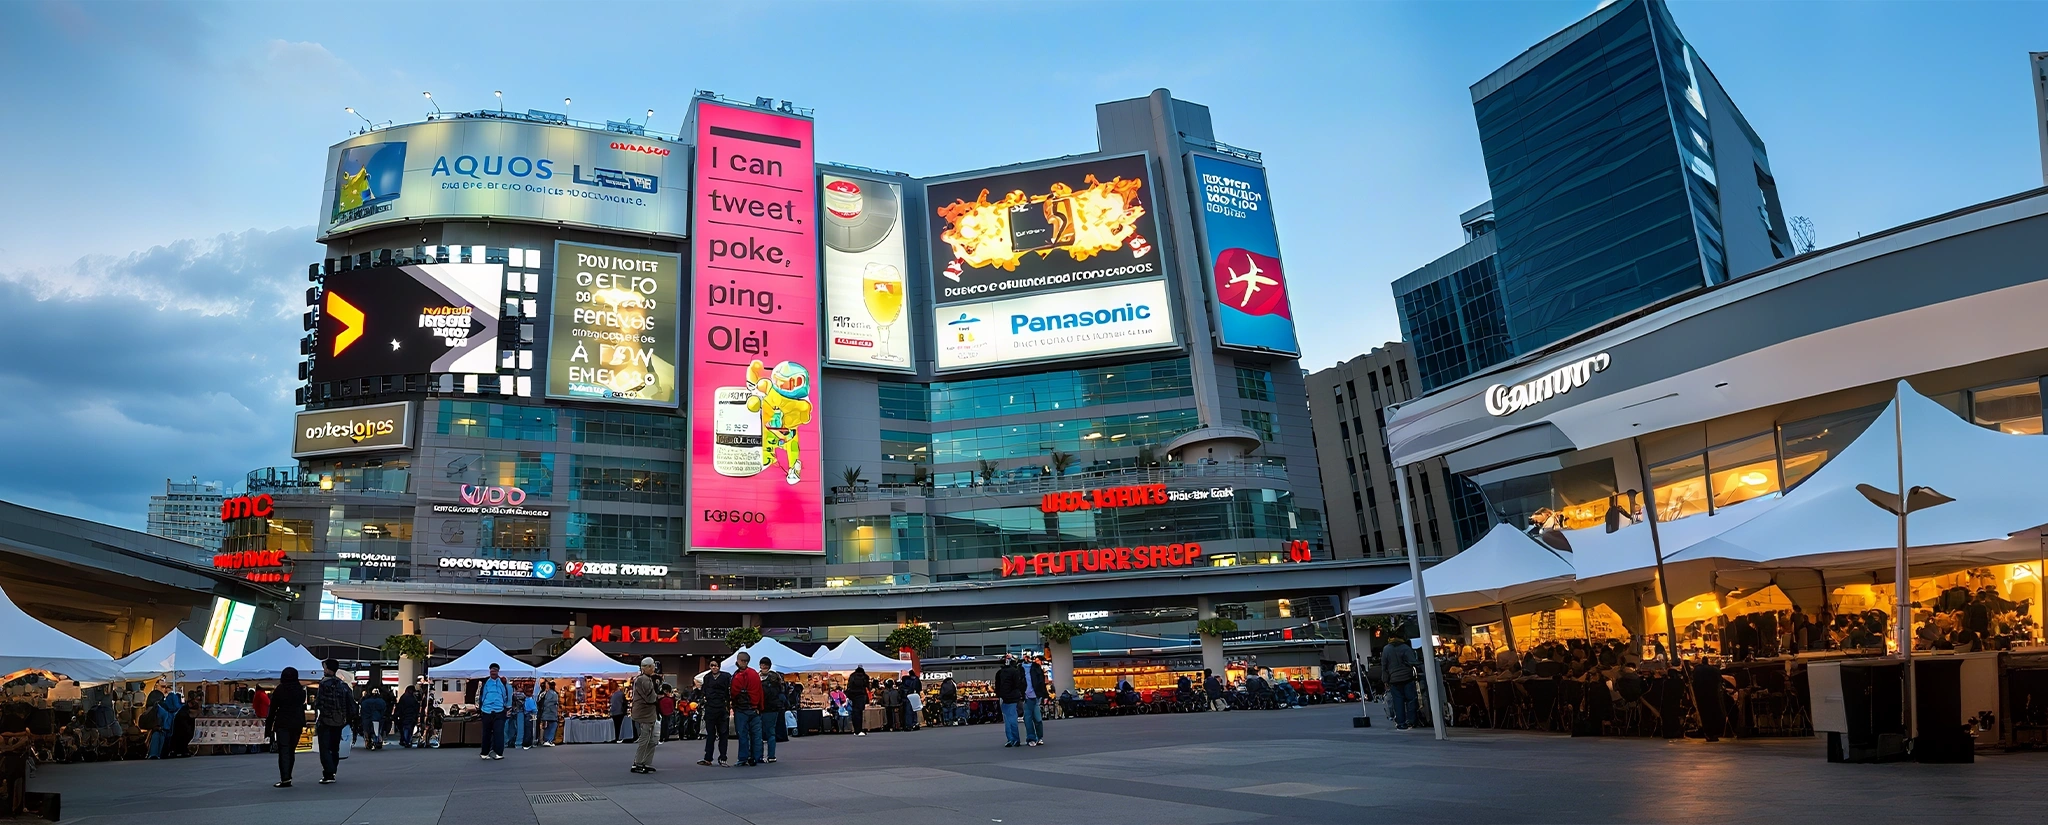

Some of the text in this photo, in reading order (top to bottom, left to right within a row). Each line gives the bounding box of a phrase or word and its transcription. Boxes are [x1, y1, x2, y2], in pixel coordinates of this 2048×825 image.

[431, 155, 554, 180] AQUOS
[712, 146, 783, 177] I can
[1011, 303, 1151, 334] Panasonic
